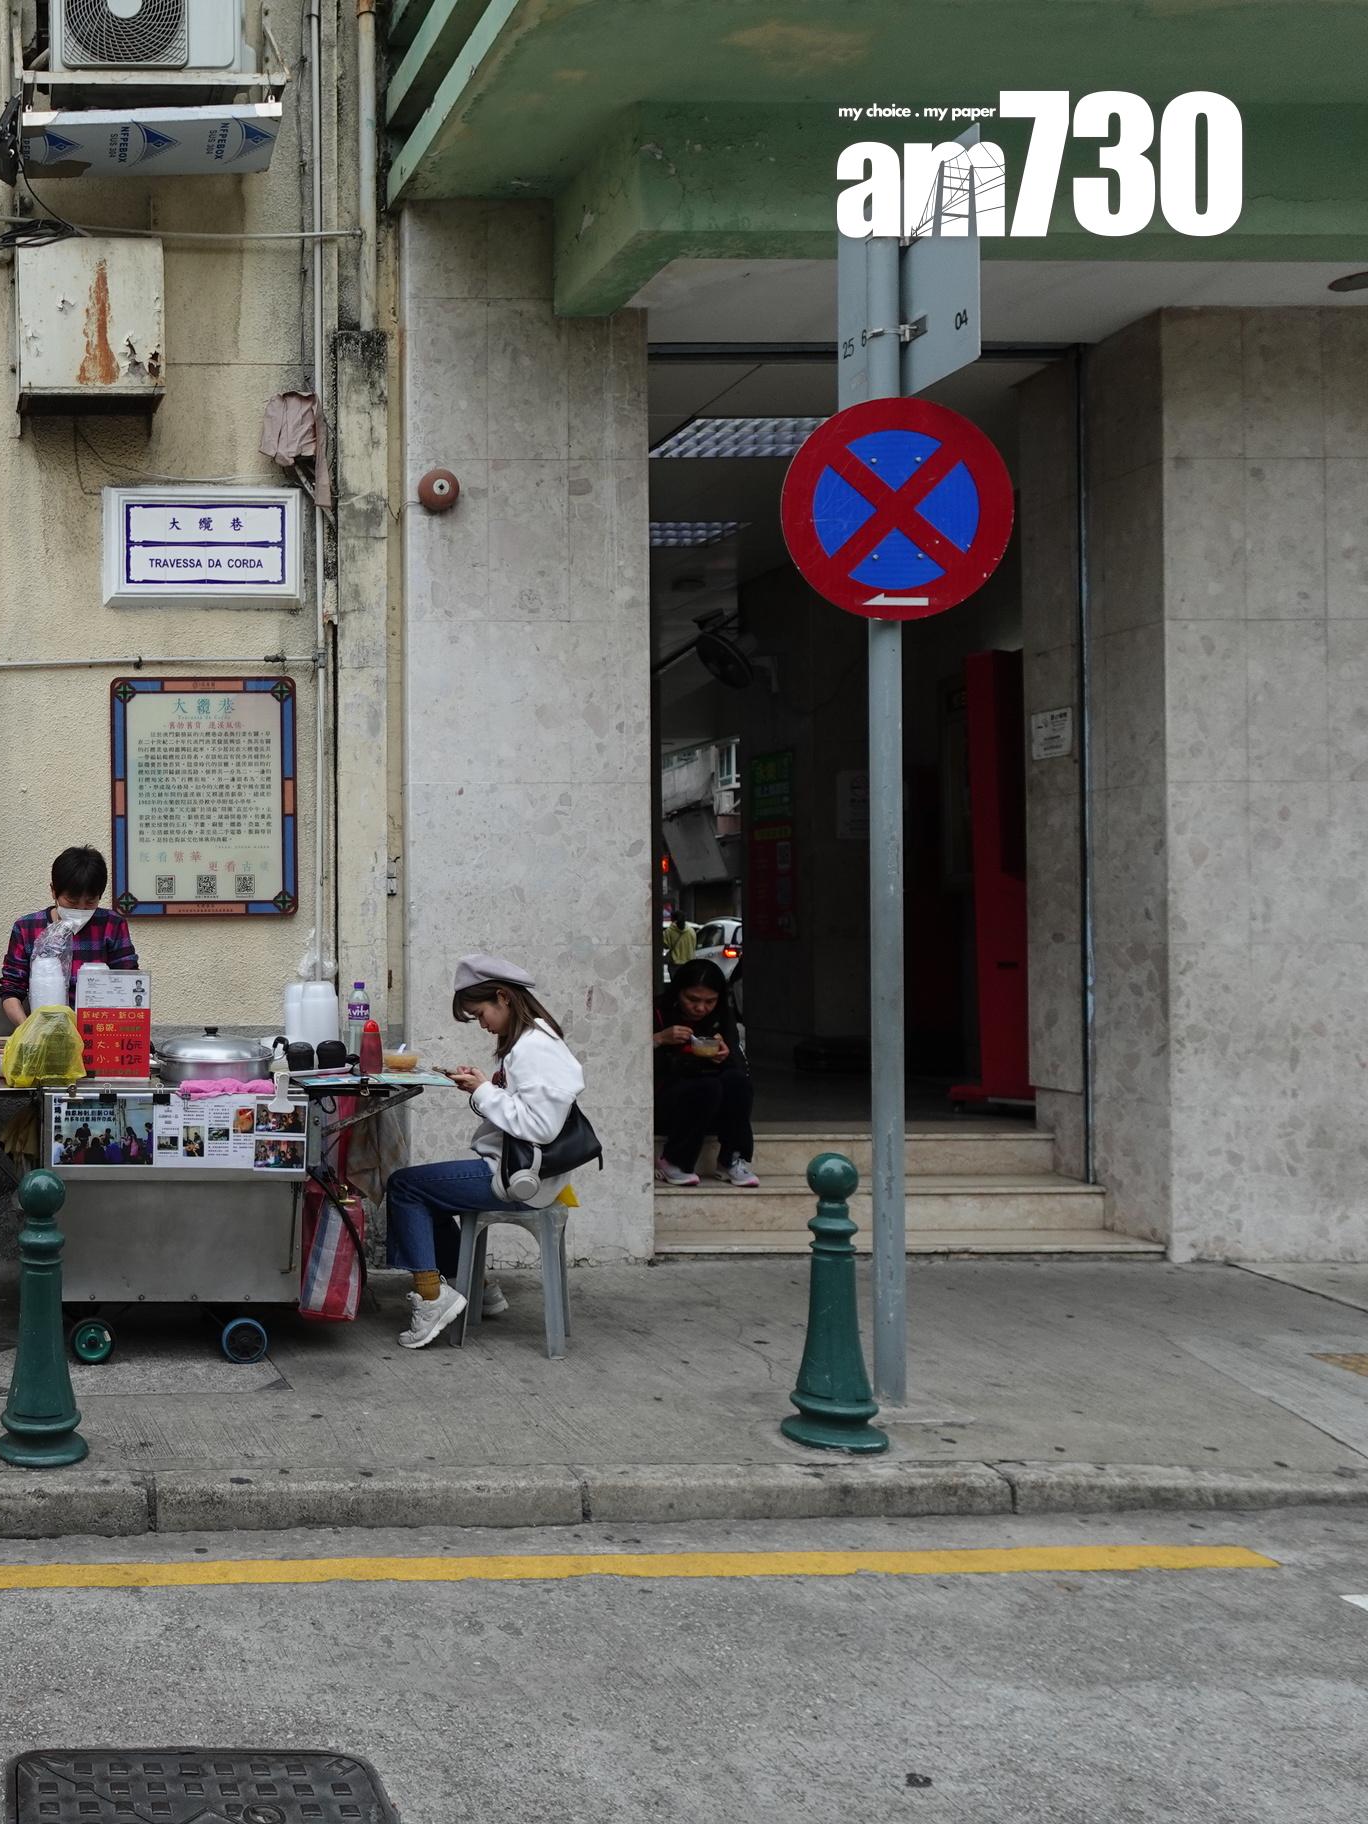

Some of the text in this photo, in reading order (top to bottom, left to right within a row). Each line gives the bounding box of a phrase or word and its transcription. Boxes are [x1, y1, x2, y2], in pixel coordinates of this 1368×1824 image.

[118, 126, 130, 163] NFPEBOX
[214, 122, 230, 160] NFPEBOX
[842, 337, 855, 359] 25
[955, 308, 968, 331] 04
[169, 517, 245, 531] 大纜巷
[149, 558, 263, 569] TRAVESSA DA CORDA
[172, 698, 236, 714] 大纜巷
